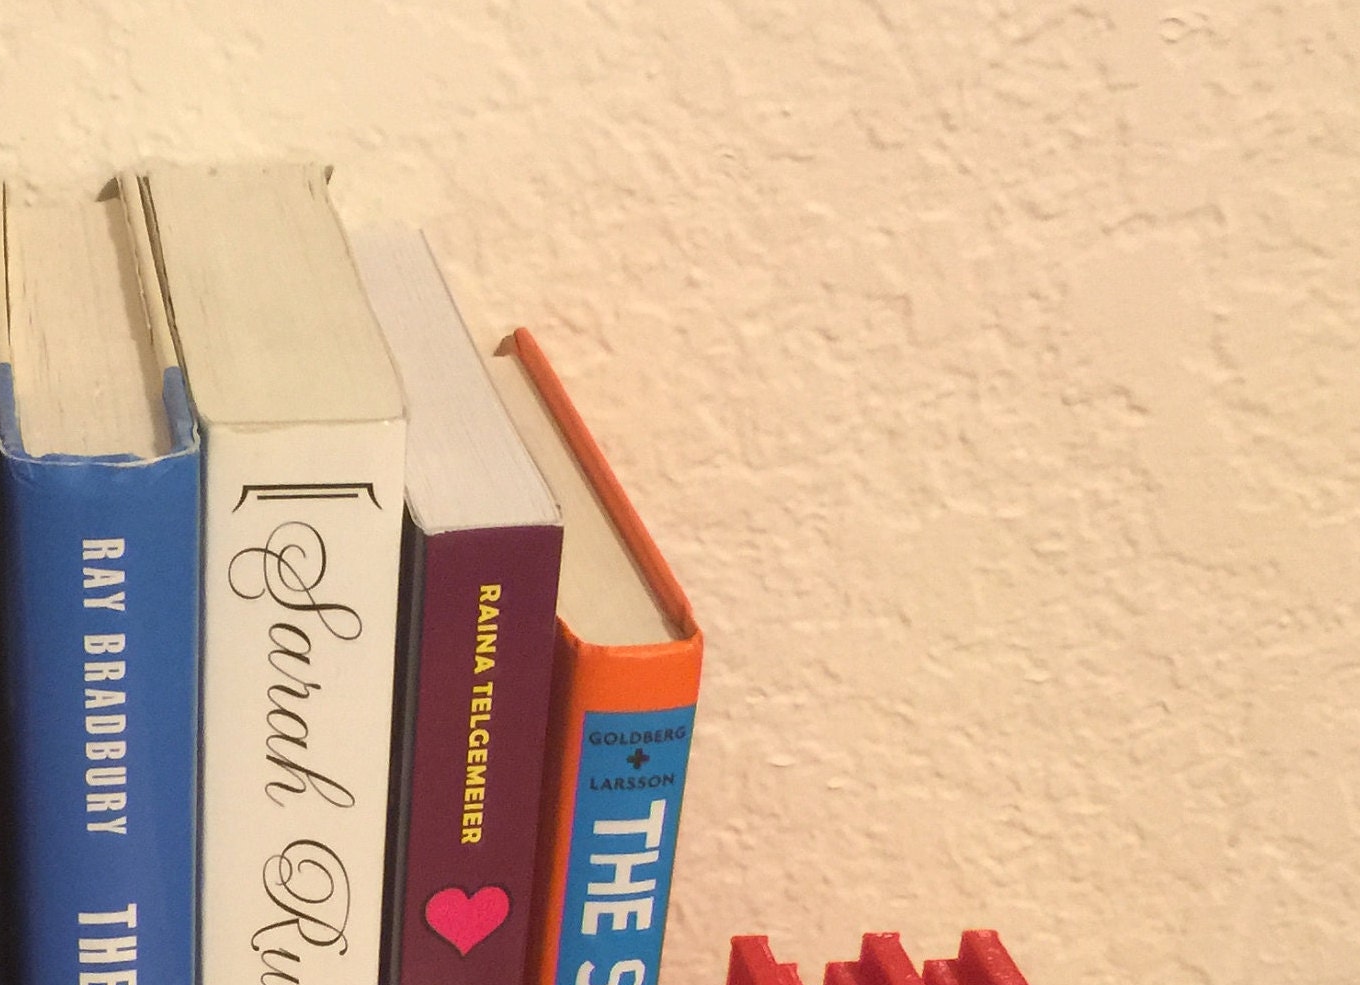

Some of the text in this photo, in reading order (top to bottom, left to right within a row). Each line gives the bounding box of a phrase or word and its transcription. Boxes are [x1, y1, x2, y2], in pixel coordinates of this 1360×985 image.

[82, 537, 128, 835] RAY BRADBURY
[228, 521, 363, 809] Sarah
[460, 584, 502, 846] RAINA TELGEMEIER
[589, 725, 686, 746] GOLDBERG
[581, 799, 667, 936] THE
[589, 773, 675, 791] LARSSON
